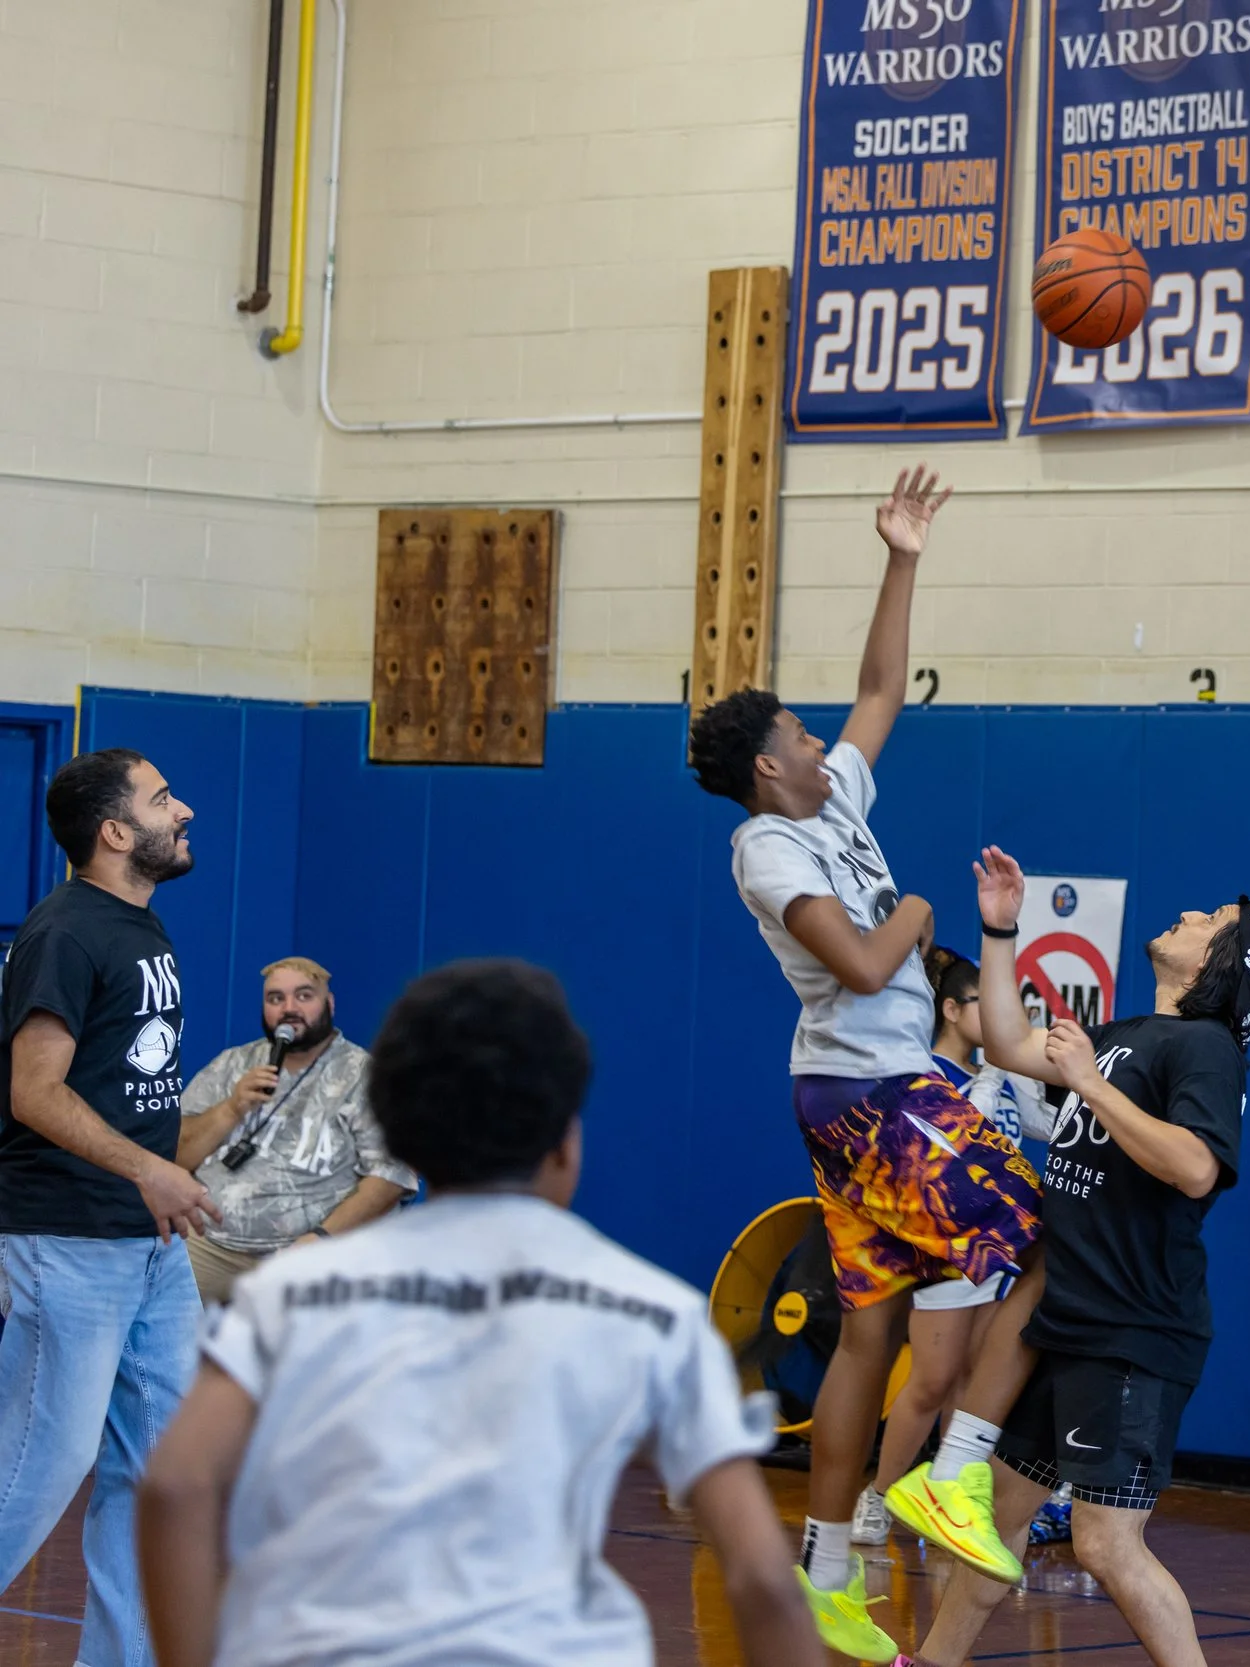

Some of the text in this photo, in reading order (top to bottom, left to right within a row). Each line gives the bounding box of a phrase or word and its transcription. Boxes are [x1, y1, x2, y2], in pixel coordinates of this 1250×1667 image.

[824, 40, 1003, 87] WARRIORS
[853, 113, 968, 158] SOCCER
[1062, 89, 1248, 145] BOYS BASKETBALL
[821, 158, 997, 213] MSAL FALL DIVISION
[1061, 136, 1248, 200] DISTRICT 14
[819, 212, 994, 267] CHAMPIONS
[809, 285, 989, 393] 2025
[289, 1117, 333, 1177] LA
[1075, 1164, 1105, 1185] THE
